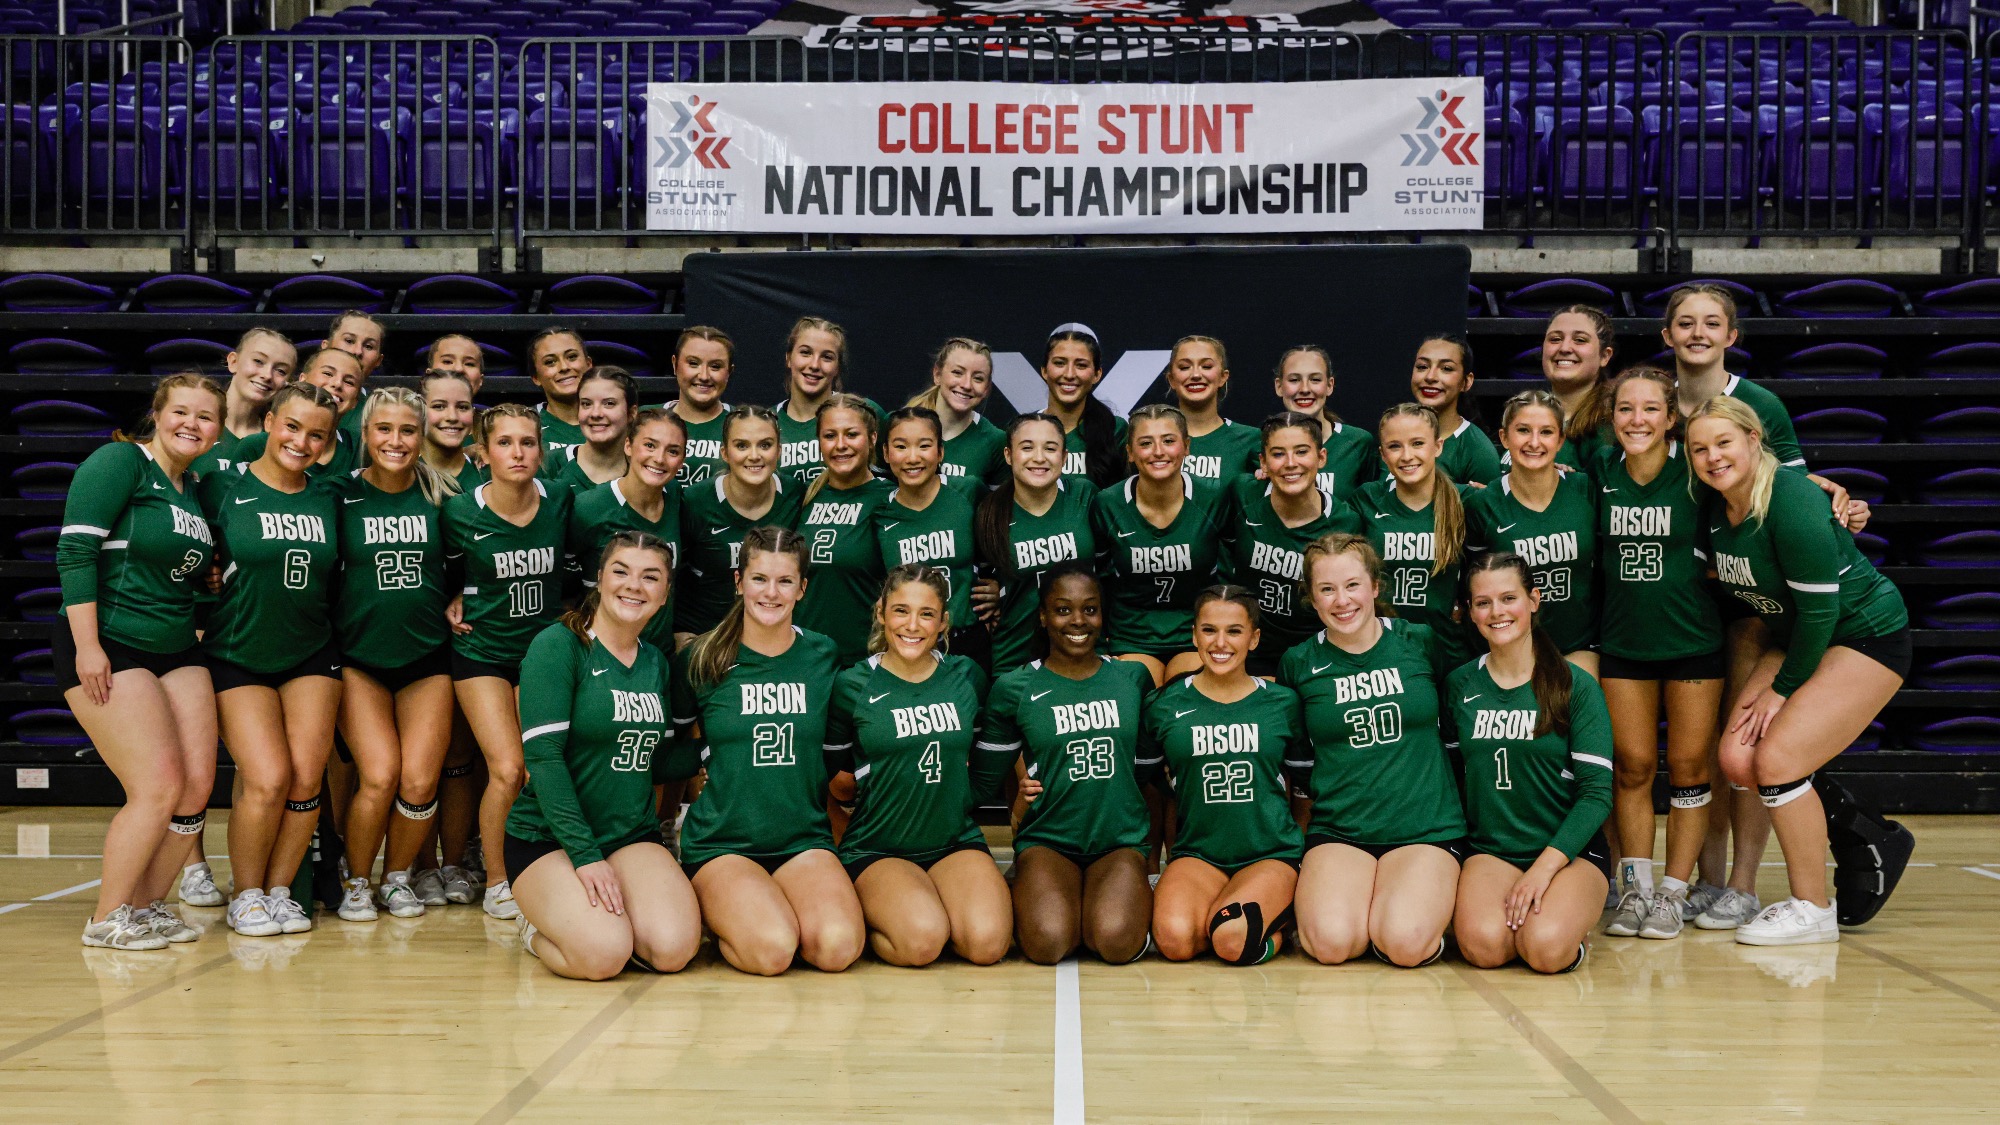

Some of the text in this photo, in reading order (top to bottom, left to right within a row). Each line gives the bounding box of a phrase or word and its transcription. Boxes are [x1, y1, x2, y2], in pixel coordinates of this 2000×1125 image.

[878, 103, 1254, 155] COLLEGE STUNT
[647, 192, 737, 206] STUNT
[658, 179, 725, 189] COLLEGE
[763, 162, 1369, 218] NATIONAL CHAMPIONSHIP
[1394, 190, 1484, 204] STUNT
[1406, 177, 1474, 186] COLLEGE
[655, 208, 727, 217] ASSOCIATION
[1404, 207, 1477, 215] ASSOCIATION
[685, 439, 721, 459] SON
[780, 439, 824, 468] BISO
[169, 504, 214, 546] BISON
[257, 512, 326, 544] BISON
[362, 515, 428, 544] BISON
[805, 503, 863, 525] BISON
[1609, 506, 1672, 537] BISON
[492, 547, 554, 579] BISON
[811, 529, 837, 564] 2
[898, 530, 956, 565] BISON
[1014, 532, 1078, 570] BISON
[1130, 544, 1191, 574] BISON
[1512, 531, 1578, 567] BISON
[1619, 542, 1663, 582] 23
[284, 549, 311, 590] 6
[375, 551, 423, 591] 25
[1393, 567, 1429, 606] 12
[1532, 567, 1571, 602] 29
[1715, 551, 1757, 587] BISON
[509, 580, 543, 618] 10
[1154, 577, 1176, 603] 7
[1259, 578, 1292, 617] 31
[740, 683, 806, 716] BISON
[1333, 667, 1404, 705] BISON
[610, 689, 664, 723] BISON
[890, 702, 961, 739] BISON
[1051, 700, 1120, 735] BISON
[1191, 723, 1259, 757] BISON
[1344, 702, 1402, 749] 30
[1471, 710, 1537, 741] BISON
[611, 730, 661, 772] 36
[753, 722, 796, 767] 21
[1066, 736, 1115, 782] 33
[918, 741, 942, 784] 4
[1494, 747, 1511, 790] 1
[1202, 761, 1254, 804] 22
